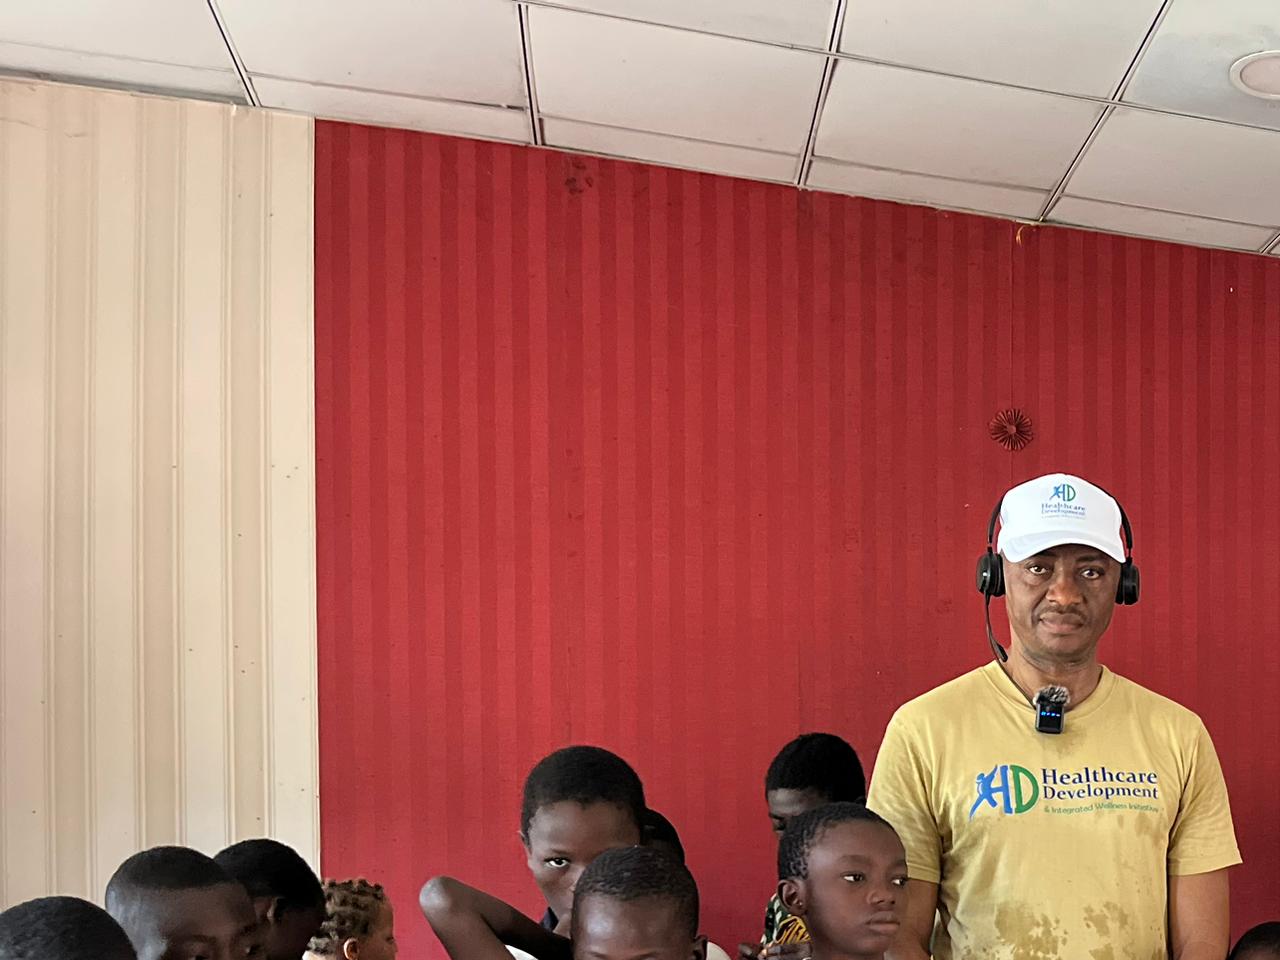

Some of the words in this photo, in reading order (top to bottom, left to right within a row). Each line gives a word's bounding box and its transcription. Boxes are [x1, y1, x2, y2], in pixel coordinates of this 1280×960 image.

[1041, 766, 1157, 785] Healthcare
[1044, 784, 1158, 800] Development
[1051, 804, 1094, 814] Integrated
